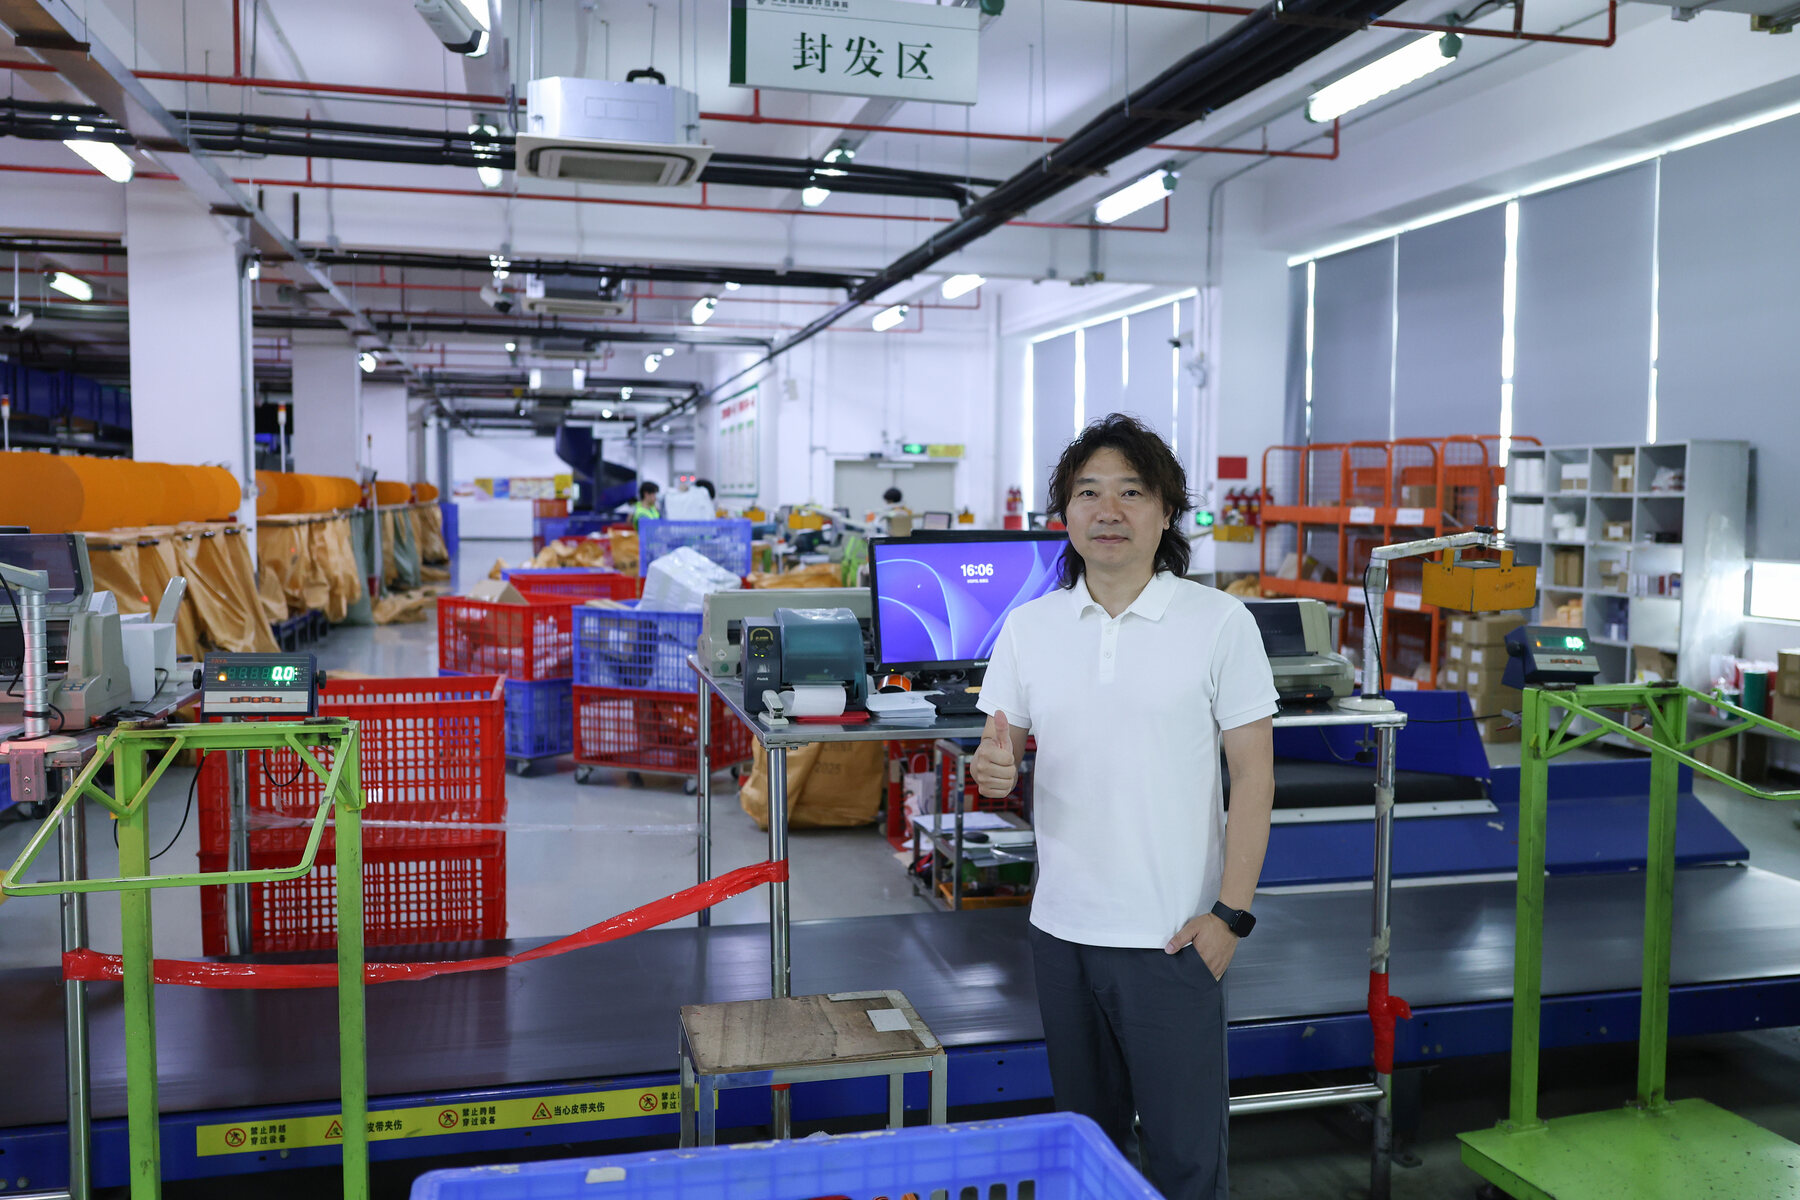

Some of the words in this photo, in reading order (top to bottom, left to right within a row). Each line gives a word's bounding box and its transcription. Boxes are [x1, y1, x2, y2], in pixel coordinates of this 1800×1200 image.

[792, 32, 934, 80] 封发区
[960, 563, 994, 577] 16:06
[272, 666, 295, 681] 0.0
[661, 1092, 680, 1100] 禁止
[554, 1102, 605, 1116] 当心皮带夹伤
[661, 1101, 680, 1110] 穿过
[462, 1106, 496, 1117] 禁止跨越
[462, 1116, 496, 1127] 穿过设备
[250, 1124, 286, 1135] 禁止跨越
[250, 1134, 286, 1146] 穿过设备
